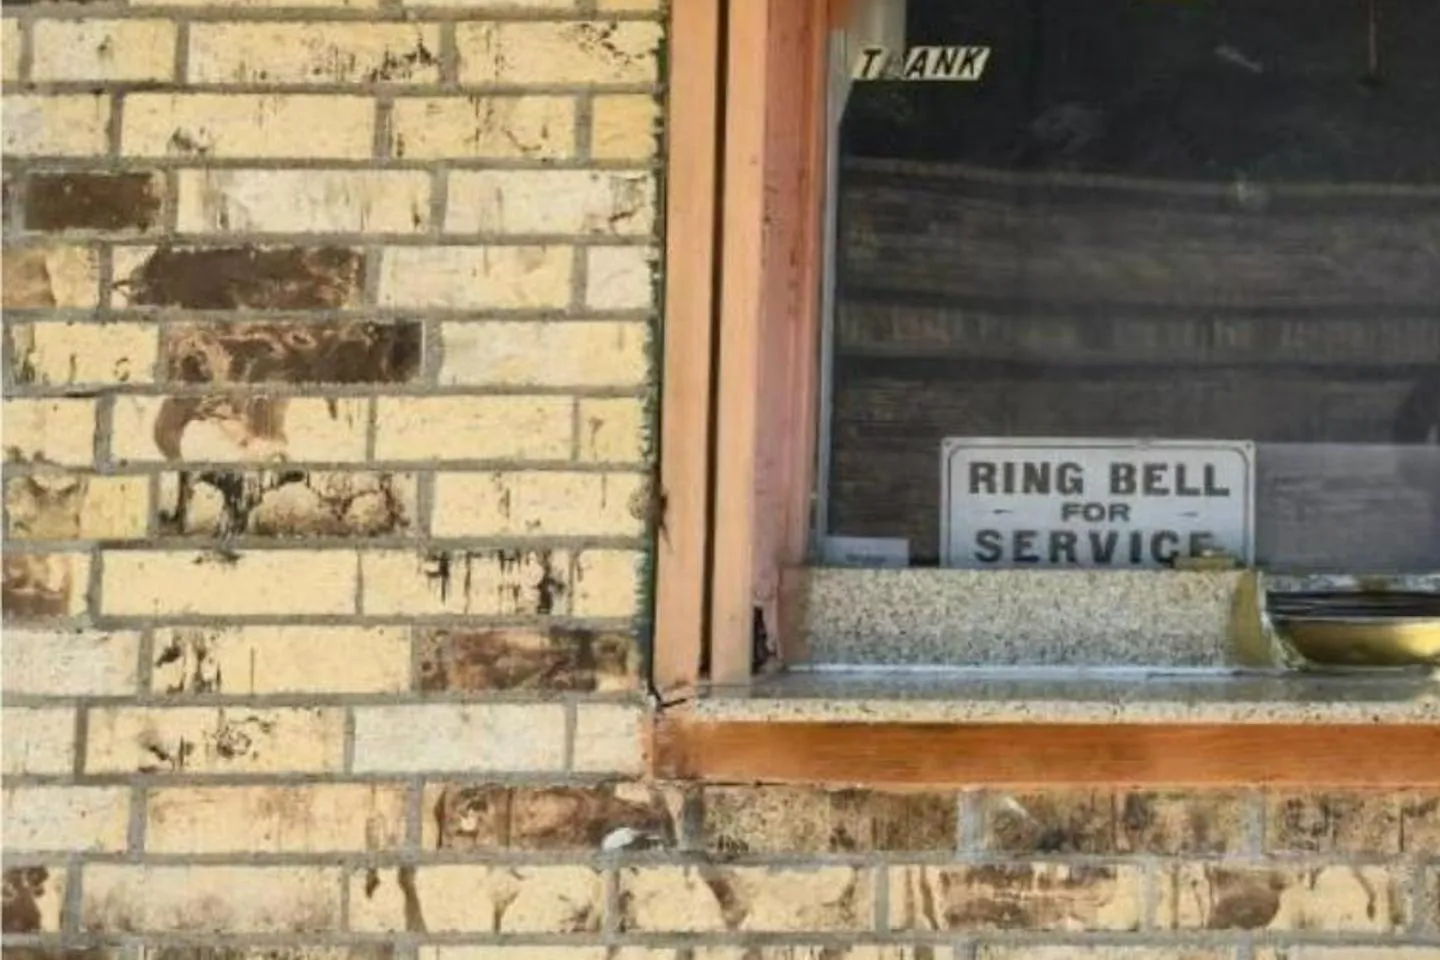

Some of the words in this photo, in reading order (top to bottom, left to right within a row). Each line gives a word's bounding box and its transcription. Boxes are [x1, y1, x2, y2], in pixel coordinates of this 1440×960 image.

[968, 461, 1084, 496] RING
[1109, 463, 1231, 497] BELL
[1060, 502, 1131, 523] FOR
[974, 529, 1214, 564] SERVICE
